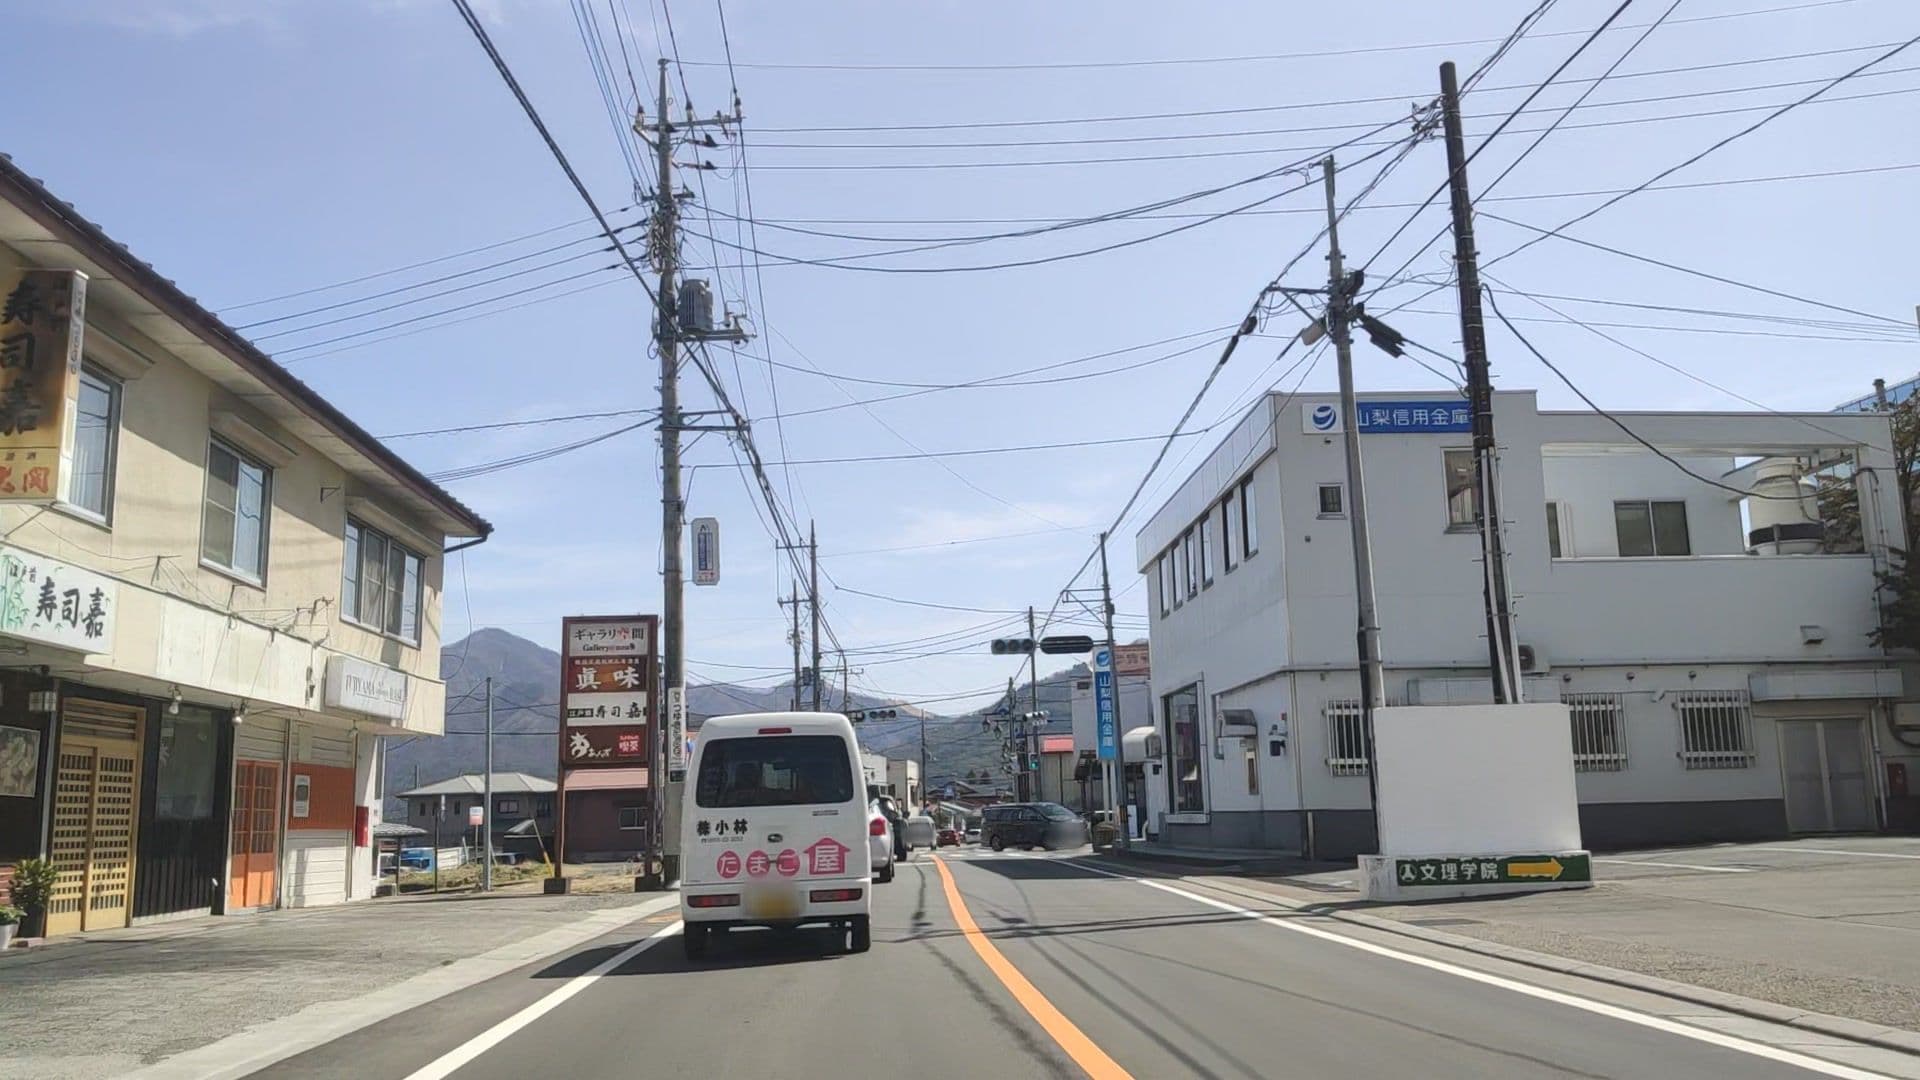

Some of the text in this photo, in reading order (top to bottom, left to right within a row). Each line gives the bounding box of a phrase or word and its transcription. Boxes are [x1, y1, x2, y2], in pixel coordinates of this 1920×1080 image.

[1358, 408, 1469, 426] 山梨信用金庫
[36, 576, 106, 639] 寿司嘉
[595, 701, 641, 718] 寿司嘉
[1100, 675, 1112, 747] 山梨信用金庫
[720, 845, 840, 872] たまご屋
[1420, 863, 1499, 880] 文理学院
